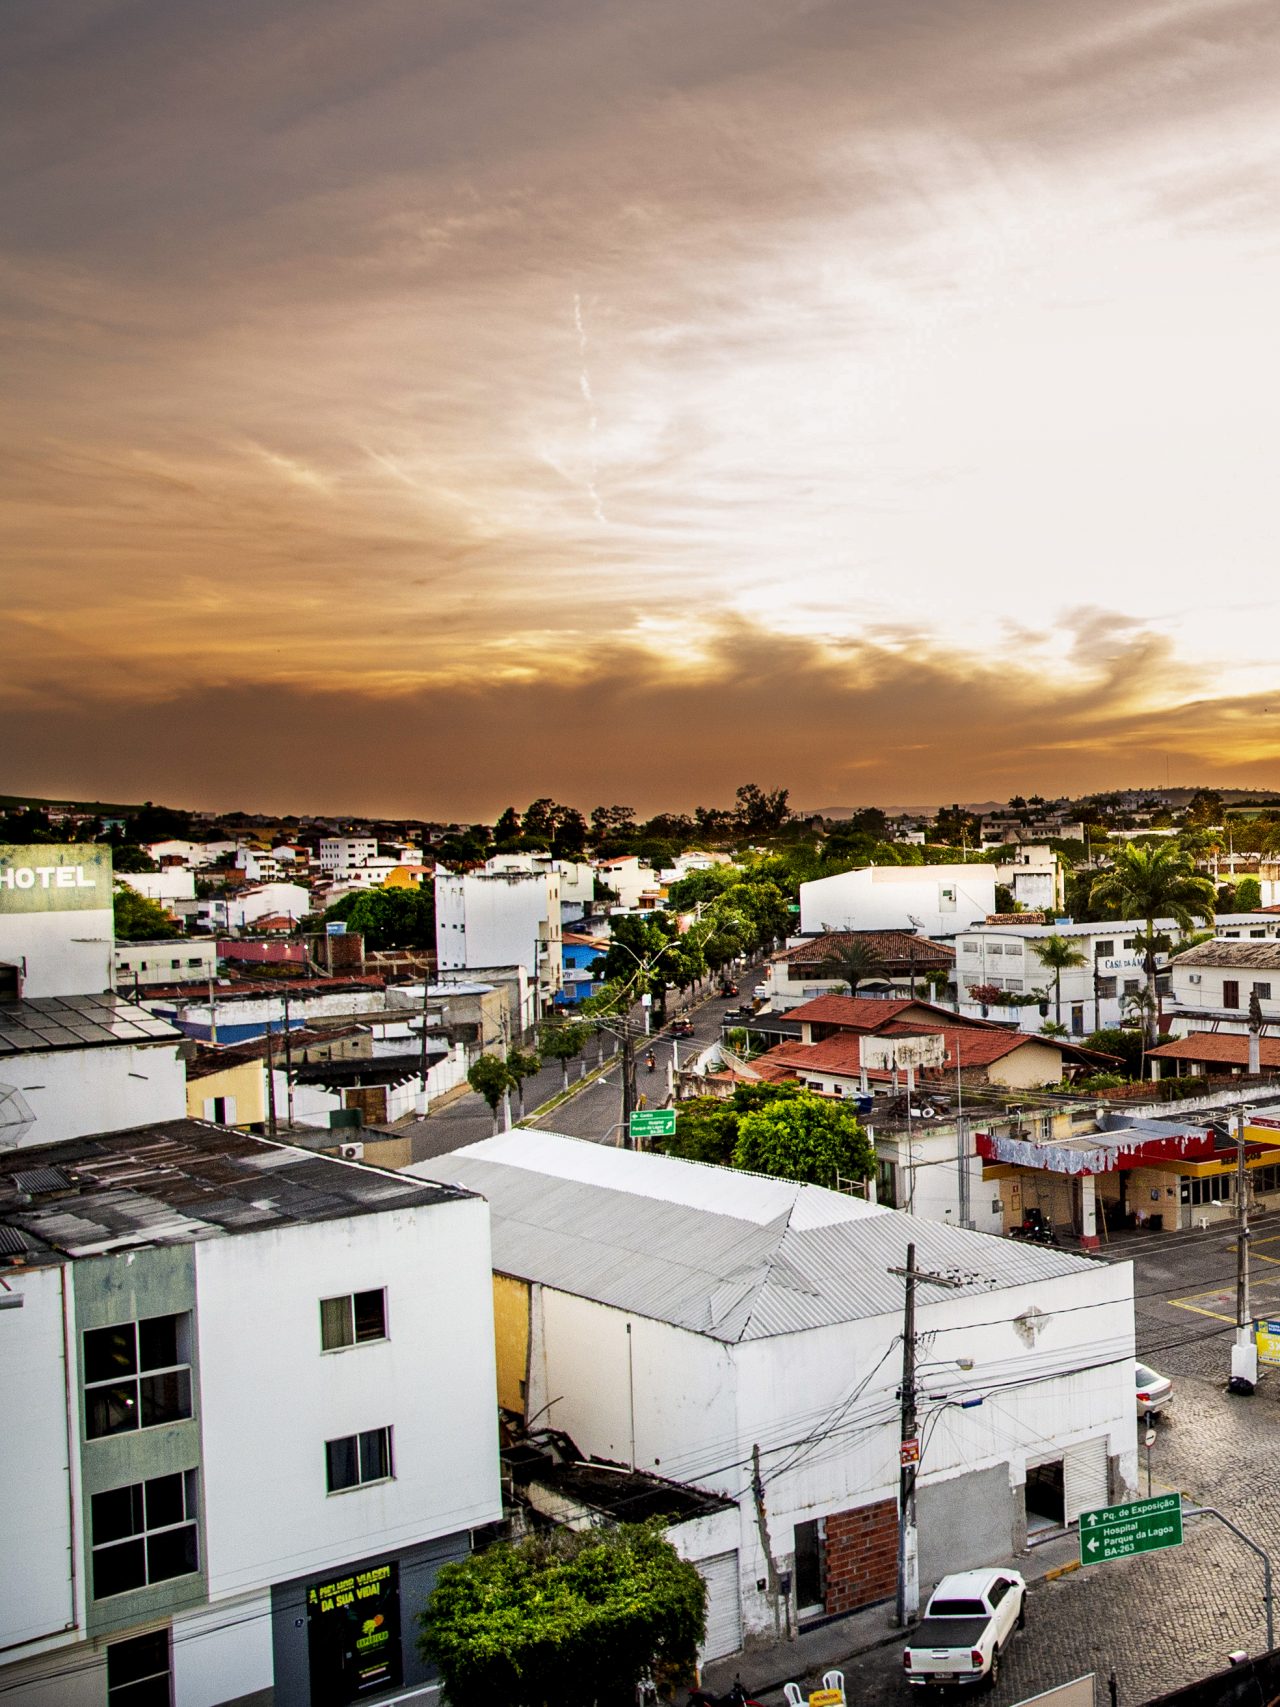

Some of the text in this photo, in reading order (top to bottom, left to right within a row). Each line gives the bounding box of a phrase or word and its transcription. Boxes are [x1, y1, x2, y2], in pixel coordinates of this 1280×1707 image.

[0, 866, 96, 889] HOTEL
[1105, 959, 1122, 969] CASA
[1103, 1499, 1175, 1520] Pq. de Exposição
[1103, 1522, 1138, 1536] Hospital
[1104, 1535, 1134, 1546] Parque
[1148, 1526, 1174, 1537] Lagoa
[1104, 1543, 1135, 1556] BA-263
[321, 1598, 334, 1613] DA
[336, 1591, 355, 1607] SUA
